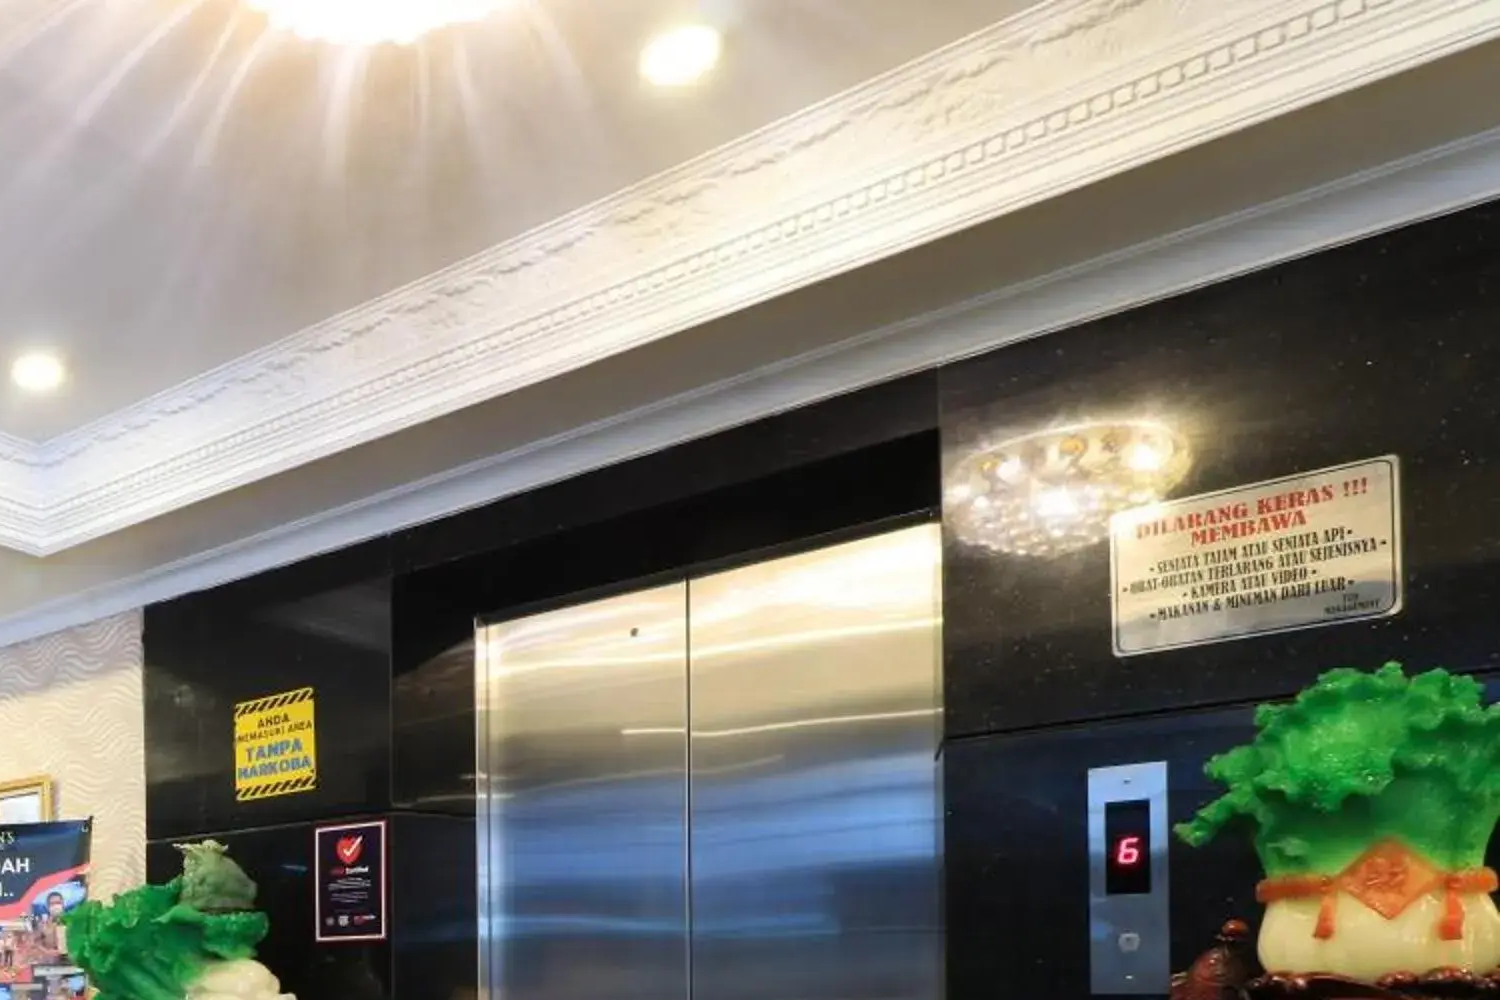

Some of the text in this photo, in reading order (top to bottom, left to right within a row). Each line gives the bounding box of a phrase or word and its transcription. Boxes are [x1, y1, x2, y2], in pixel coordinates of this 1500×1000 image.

[1137, 503, 1248, 539] DILARANG
[1257, 484, 1334, 515] KERAS
[1191, 510, 1307, 547] MEMBAWA
[1191, 580, 1237, 599] KAMERA
[1271, 568, 1308, 584] VIDEO
[257, 713, 290, 728] ANDA
[246, 738, 303, 761] TANPA
[1118, 837, 1140, 864] 6
